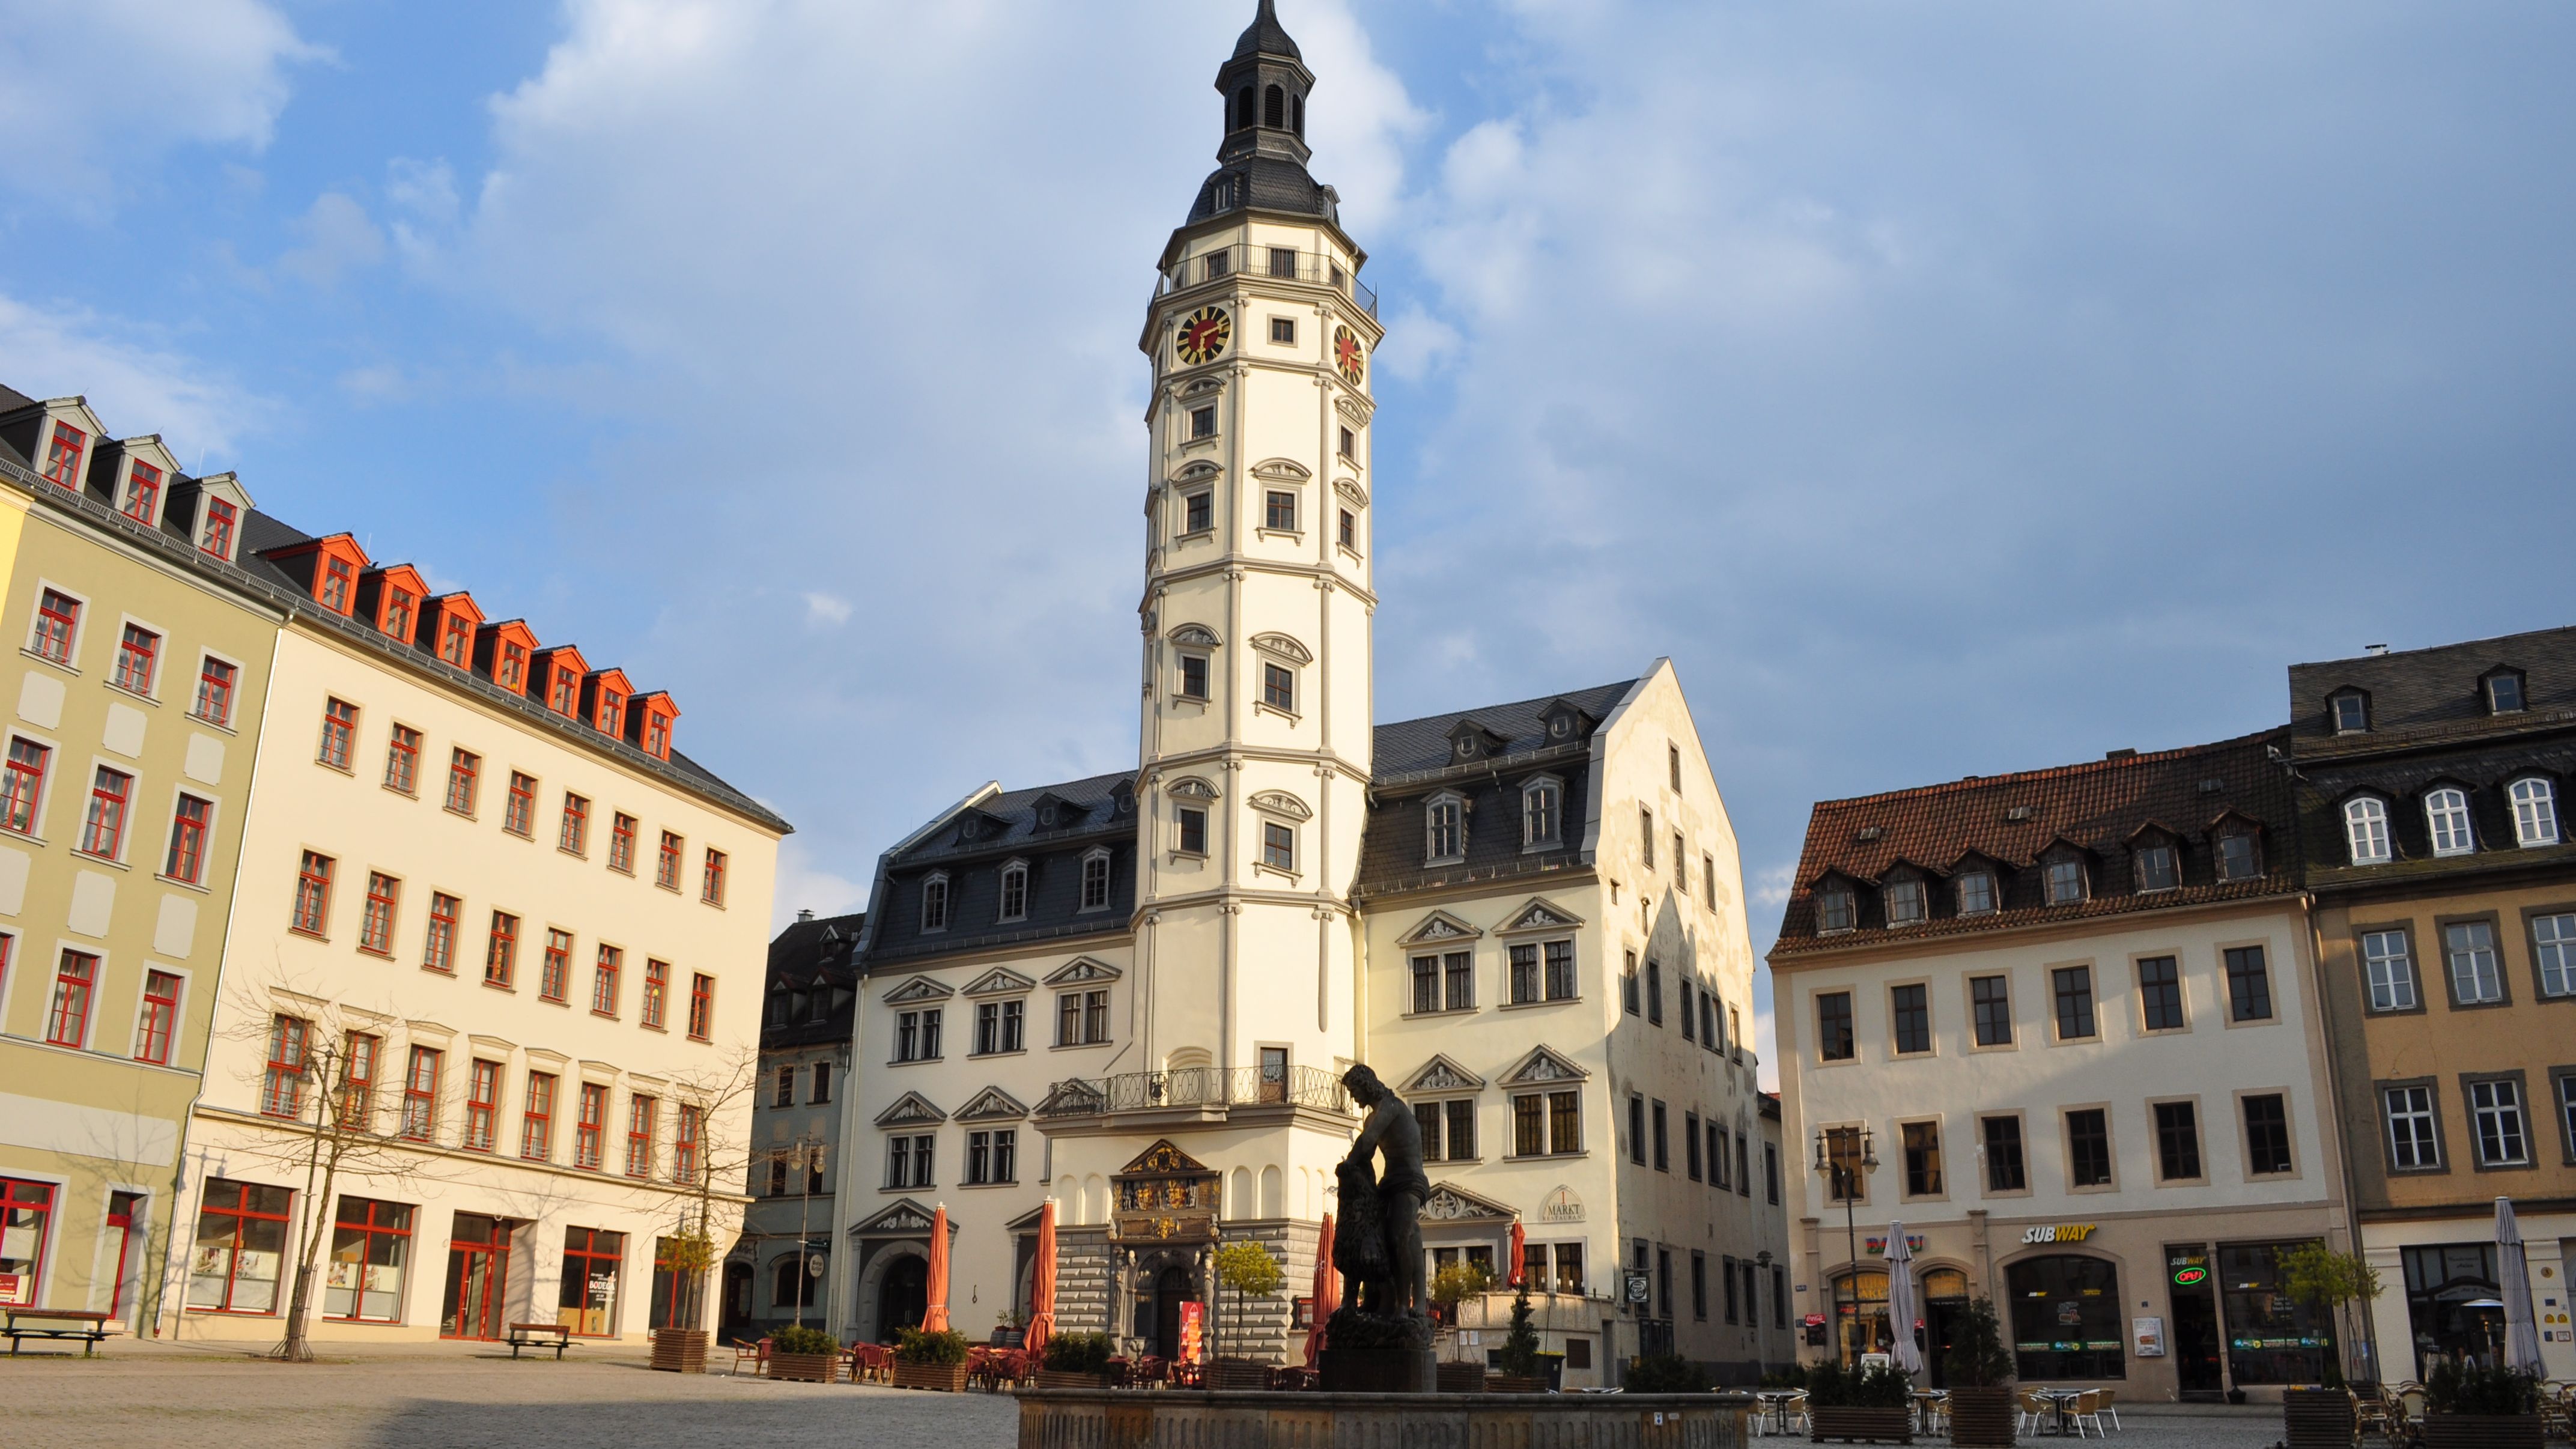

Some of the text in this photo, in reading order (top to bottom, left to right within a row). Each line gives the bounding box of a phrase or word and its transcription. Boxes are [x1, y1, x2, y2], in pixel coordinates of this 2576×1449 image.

[1548, 1204, 1581, 1215] MARKT
[2021, 1224, 2096, 1244] SUBWAY
[1865, 1235, 1924, 1254] BAU
[2170, 1256, 2207, 1266] SUBWAY
[589, 1280, 615, 1292] BODEGA
